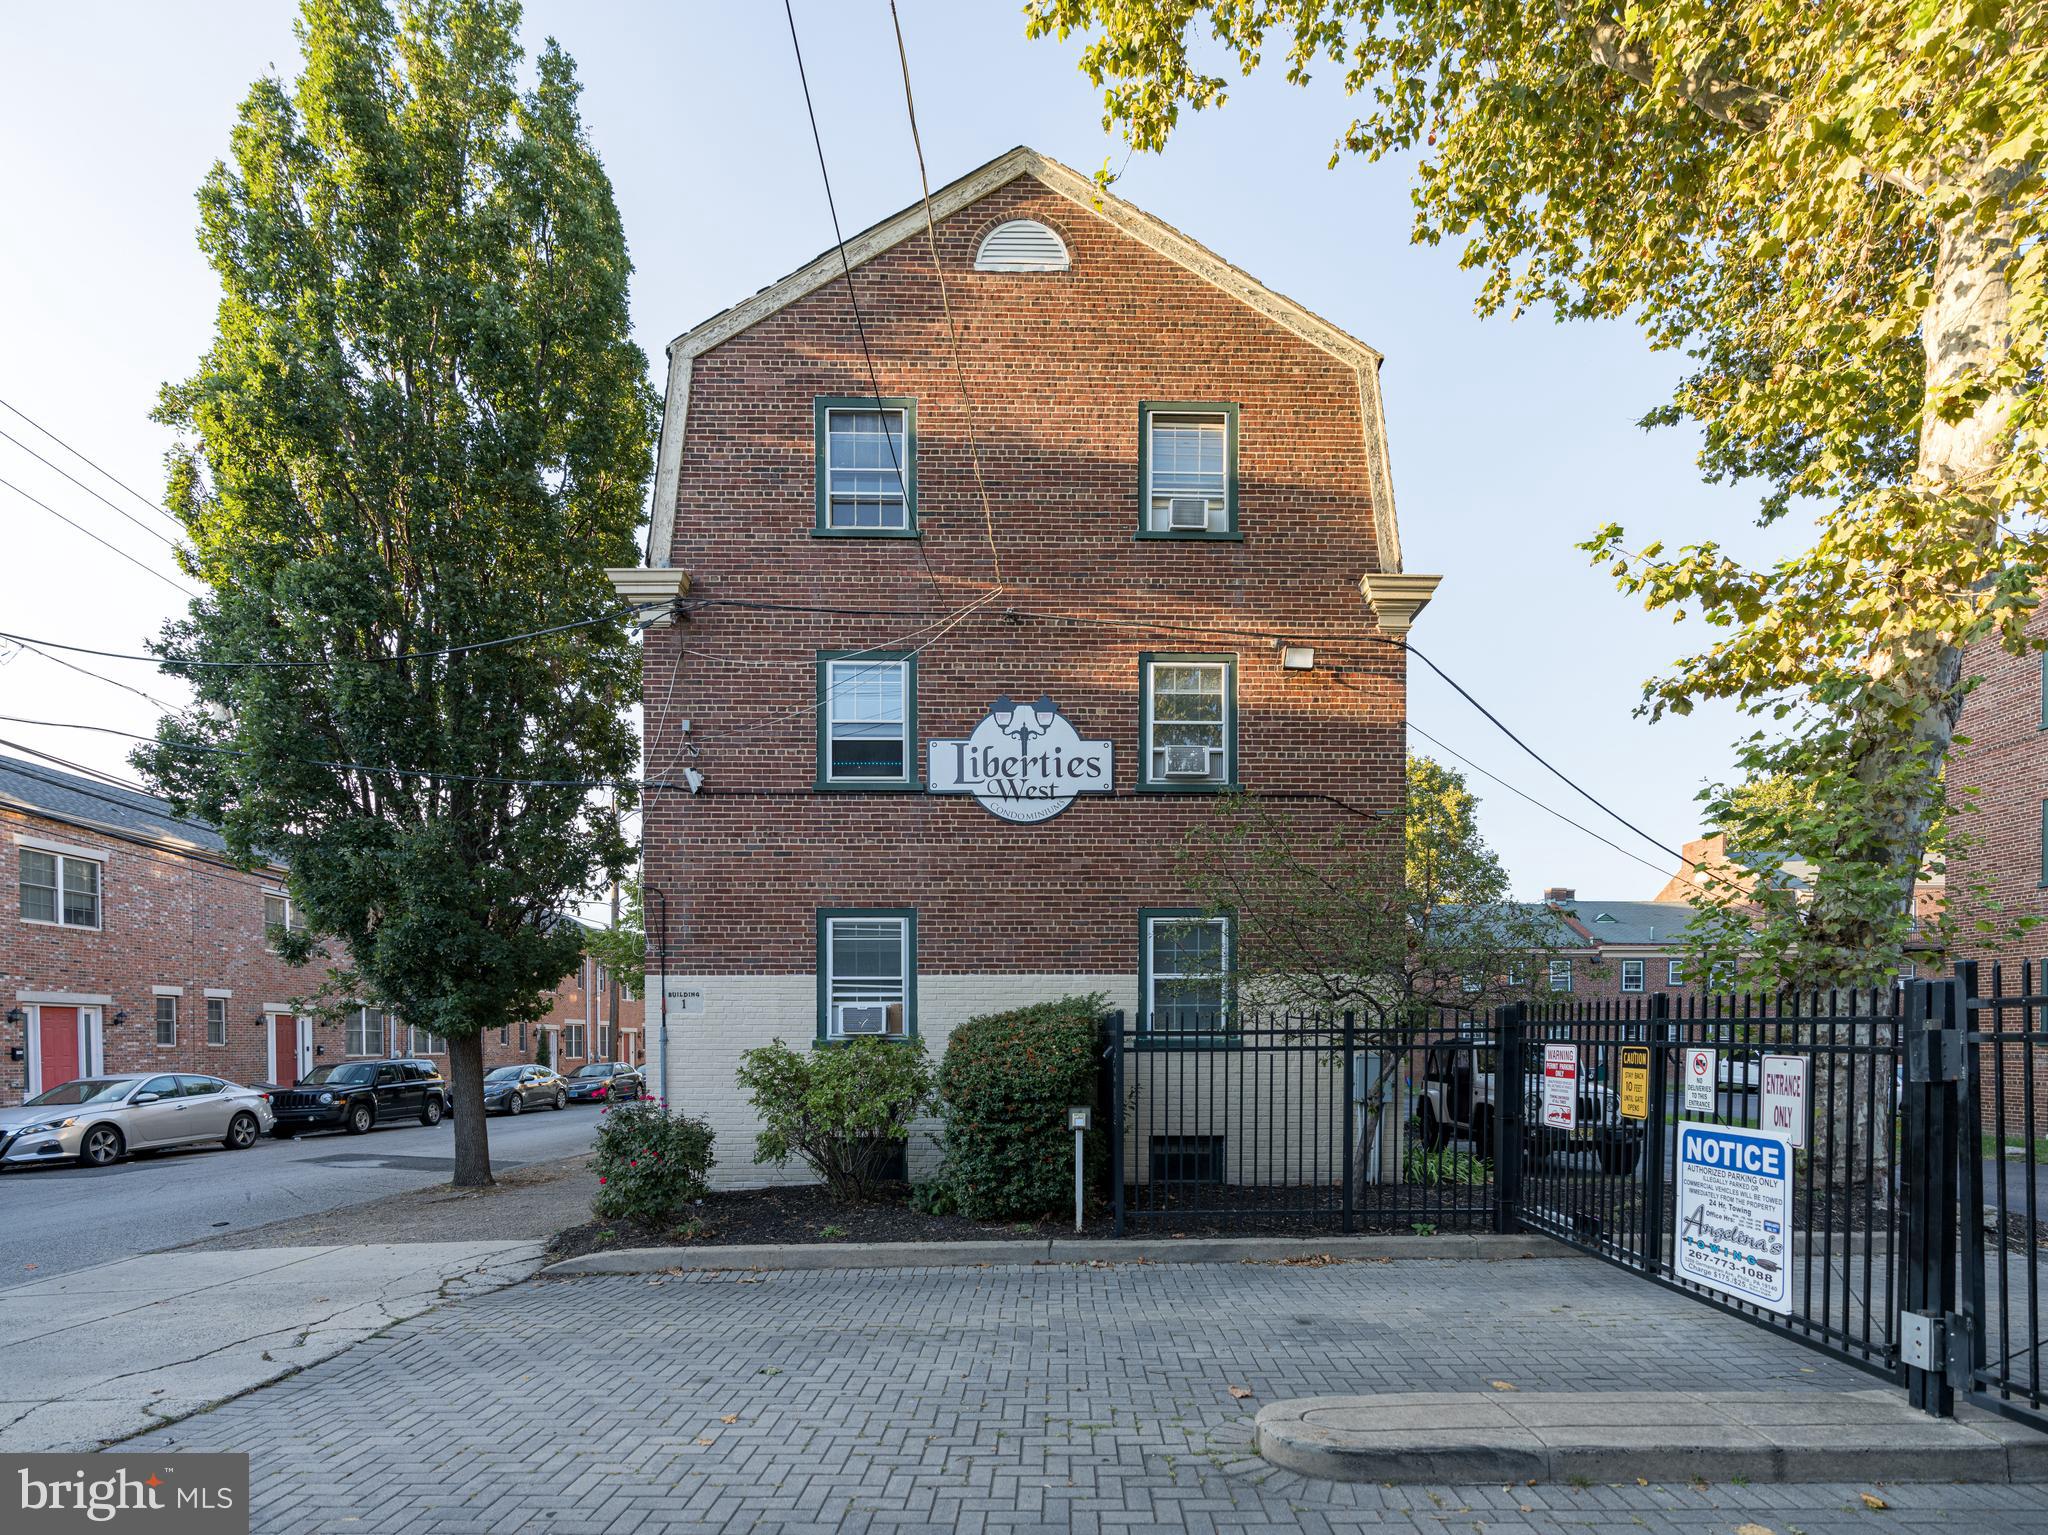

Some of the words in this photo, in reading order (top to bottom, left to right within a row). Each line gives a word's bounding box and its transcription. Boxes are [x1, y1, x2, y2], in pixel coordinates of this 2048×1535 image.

[950, 742, 1101, 785] Liberties
[987, 778, 1060, 803] West
[990, 799, 1067, 821] CONDOMINIUMS
[681, 998, 687, 1009] 1
[1547, 1049, 1574, 1061] WARNING
[1623, 1052, 1647, 1065] CAUTION
[1625, 1071, 1634, 1079] STAY
[1634, 1072, 1644, 1080] BACK
[1626, 1081, 1633, 1092] 10
[1634, 1084, 1643, 1092] FEET
[1687, 1084, 1712, 1093] DELIVERIES
[1766, 1073, 1801, 1097] ENTRANCE
[1688, 1099, 1711, 1108] ENTRANCE
[1698, 1092, 1708, 1100] THIS
[1627, 1104, 1640, 1112] OPENS
[1773, 1105, 1793, 1128] ONLY
[1686, 1136, 1779, 1175] NOTICE
[1687, 1164, 1727, 1178] AUTHORIZED
[1728, 1171, 1758, 1185] PARKING
[1759, 1177, 1778, 1189] ONLY
[1703, 1175, 1728, 1186] ILLEGALLY
[1729, 1180, 1750, 1191] PARKED
[1684, 1179, 1714, 1191] COMMERCIAL
[1715, 1185, 1740, 1196] VEHICLES
[1740, 1191, 1753, 1199] WILL
[1753, 1193, 1761, 1201] BE
[1762, 1195, 1783, 1206] TOWED
[1689, 1188, 1719, 1199] IMMEDIATELY
[1720, 1194, 1735, 1203] FROM
[1736, 1198, 1746, 1206] THE
[1747, 1200, 1776, 1213] PROPERTY
[1705, 1210, 1723, 1220] Office
[1728, 1203, 1752, 1217] Towing
[1683, 1203, 1783, 1256] Angelina's
[1687, 1235, 1757, 1266] TOWING
[1688, 1249, 1773, 1283] 267-773-1088
[1688, 1262, 1712, 1277] Charge
